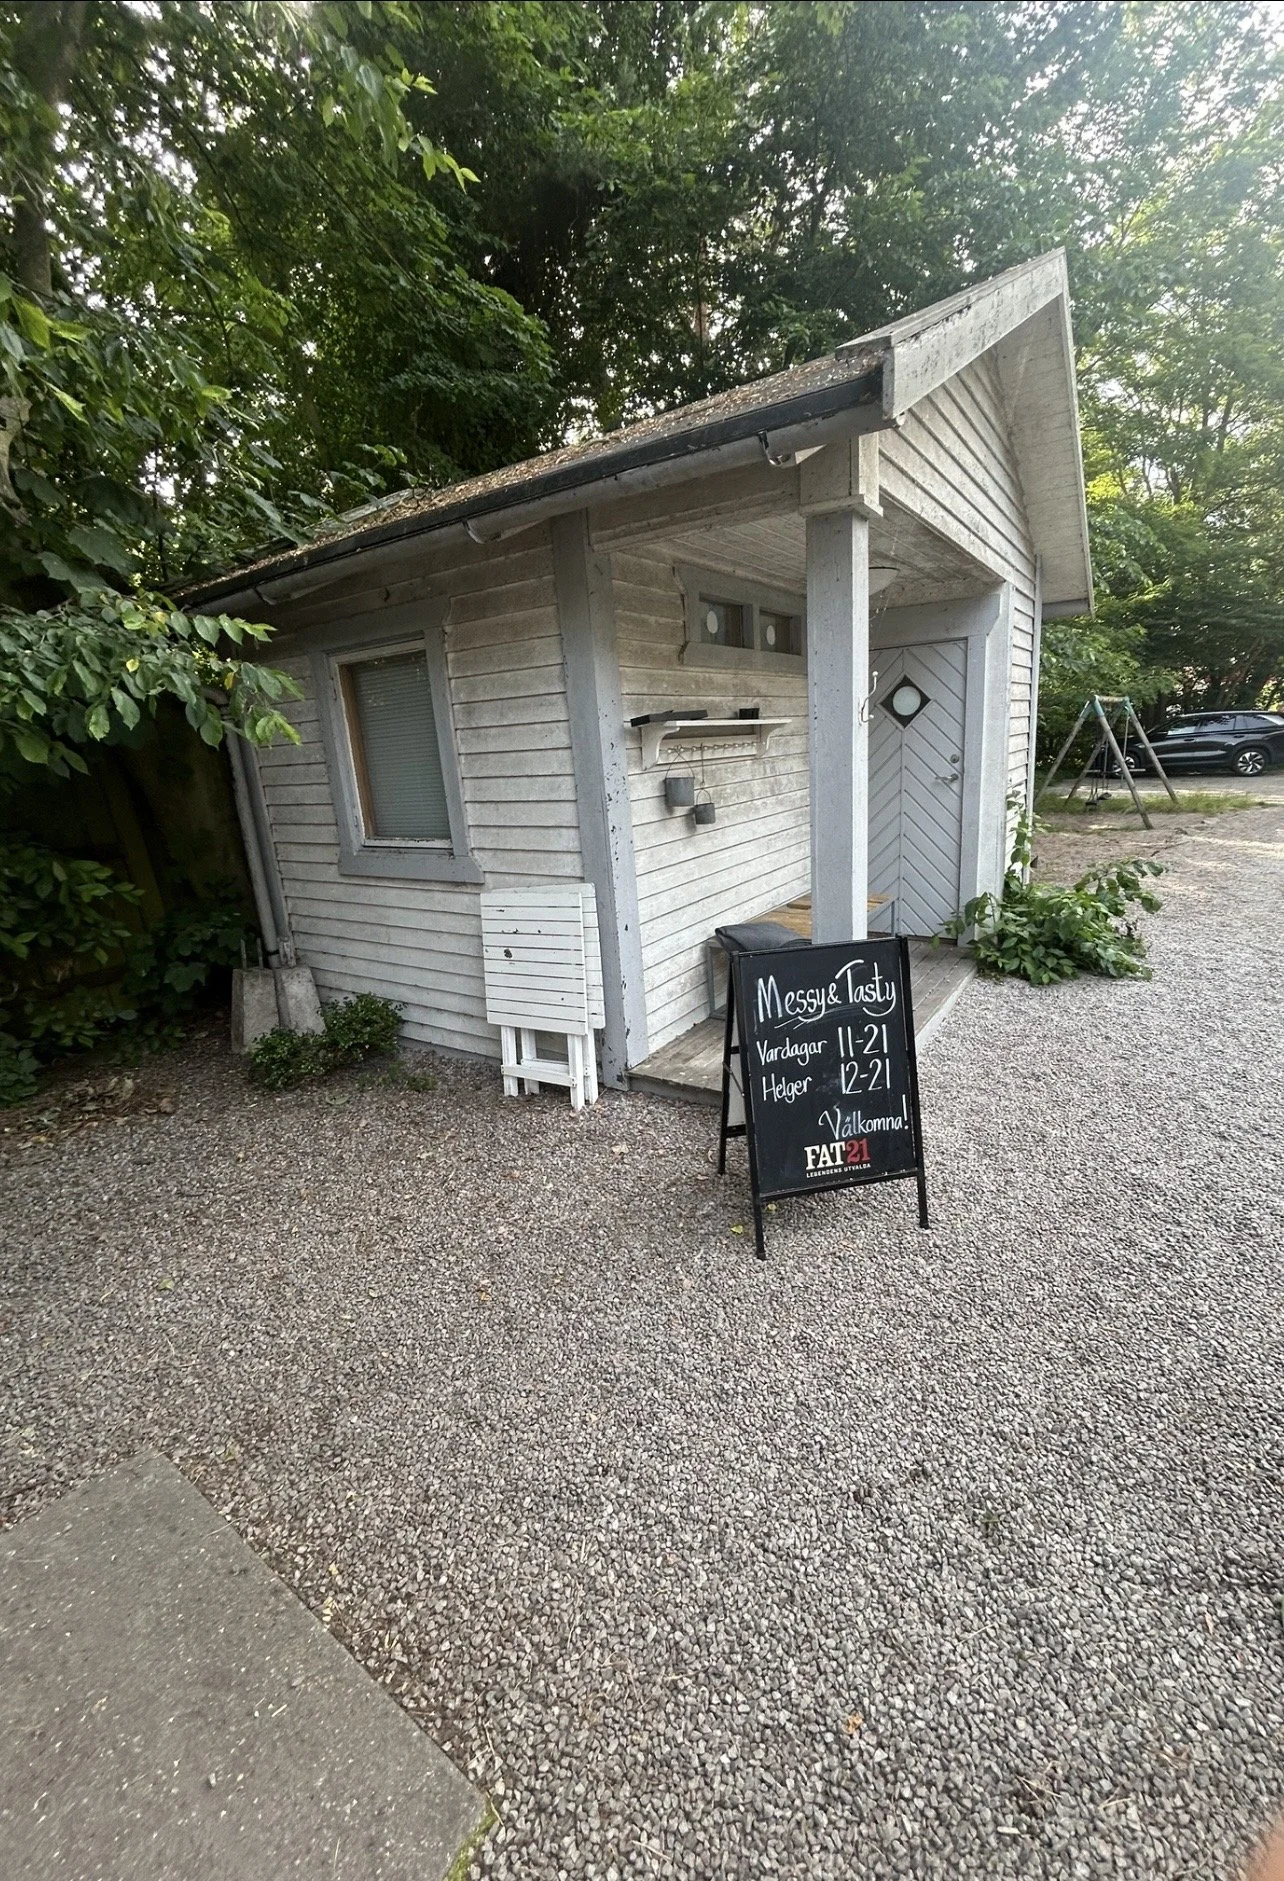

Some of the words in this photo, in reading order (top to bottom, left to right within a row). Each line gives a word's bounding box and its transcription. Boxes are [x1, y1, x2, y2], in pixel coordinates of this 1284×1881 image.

[758, 975, 825, 1023] Messy
[835, 959, 896, 1016] Tasty
[756, 1037, 828, 1066] Vardagar
[838, 1024, 888, 1058] 11-21
[762, 1073, 812, 1103] Helger
[840, 1058, 891, 1094] 12-21
[818, 1094, 909, 1140] Välkomna!
[843, 1163, 871, 1172] UTVALDA
